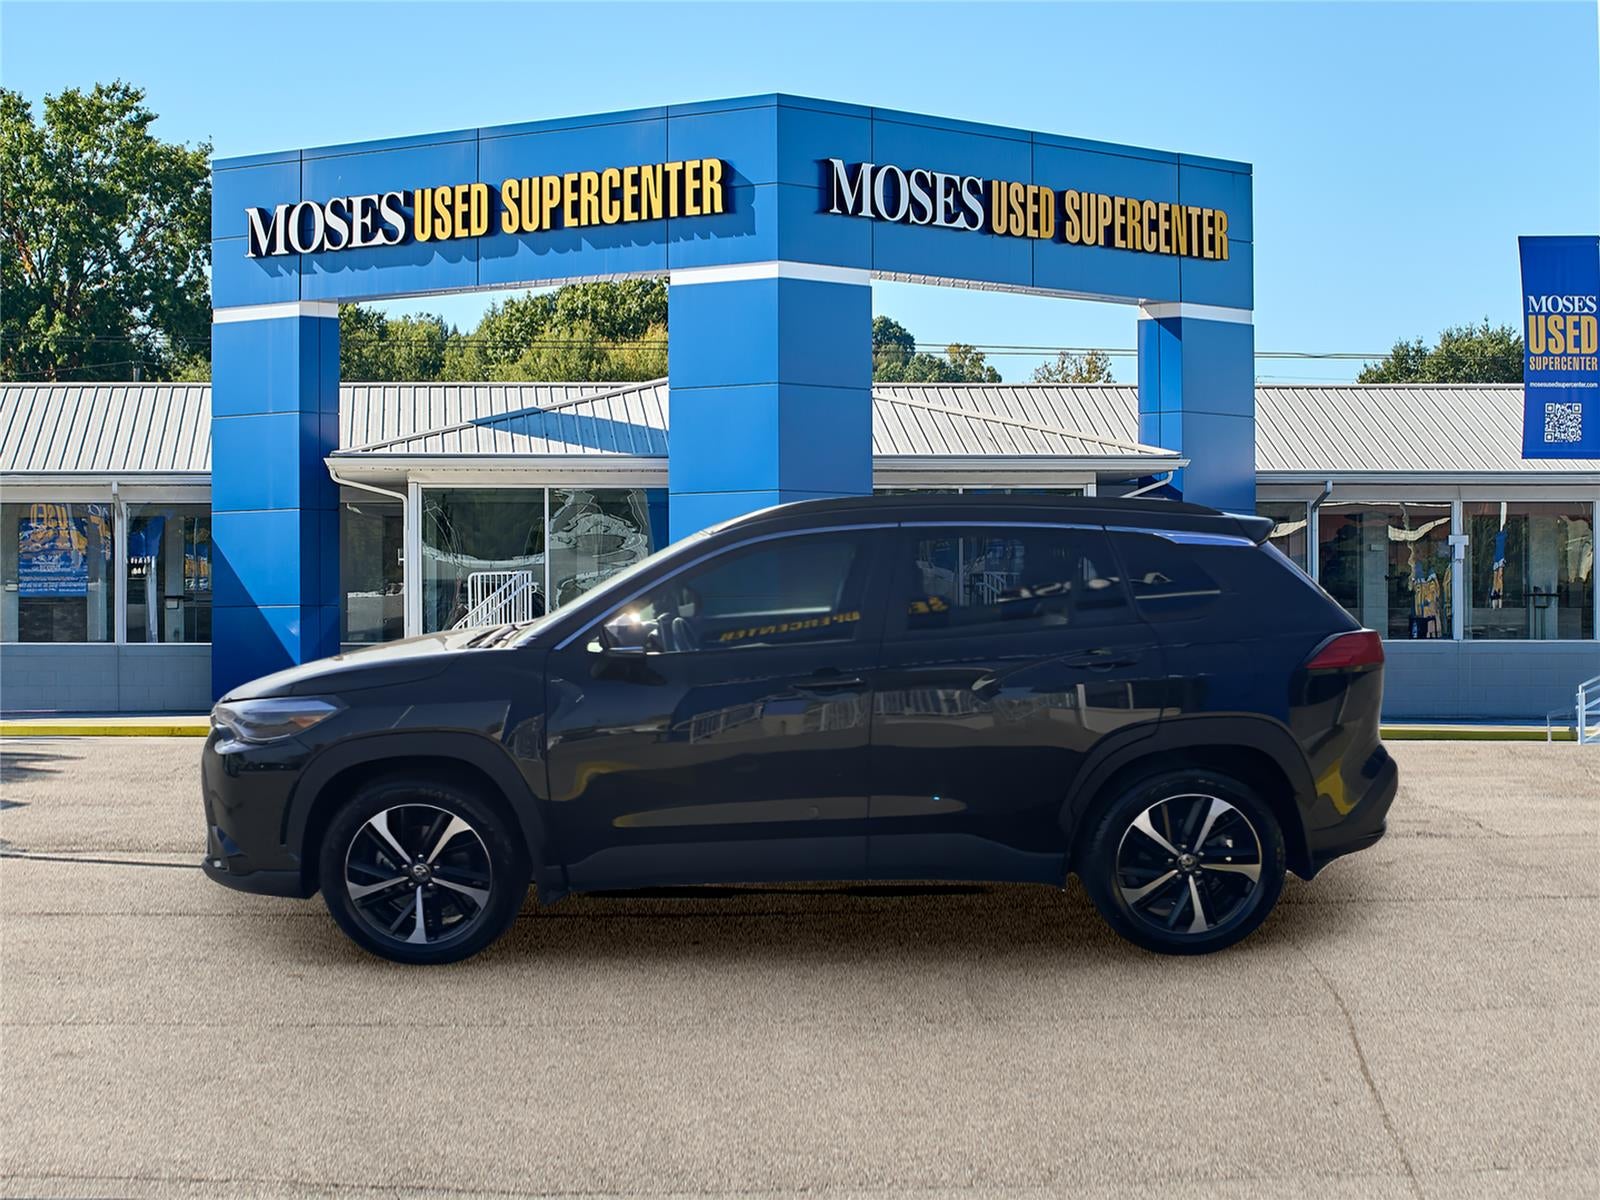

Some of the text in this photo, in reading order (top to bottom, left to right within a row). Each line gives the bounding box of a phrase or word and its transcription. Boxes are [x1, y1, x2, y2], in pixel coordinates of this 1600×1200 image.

[244, 158, 723, 258] MOSES USED SUPERCENTER
[829, 158, 1229, 261] MOSES USED SUPERCENTER
[1527, 295, 1597, 314] MOSES
[1527, 314, 1598, 355] USED
[1529, 356, 1598, 371] SUPERCENTER
